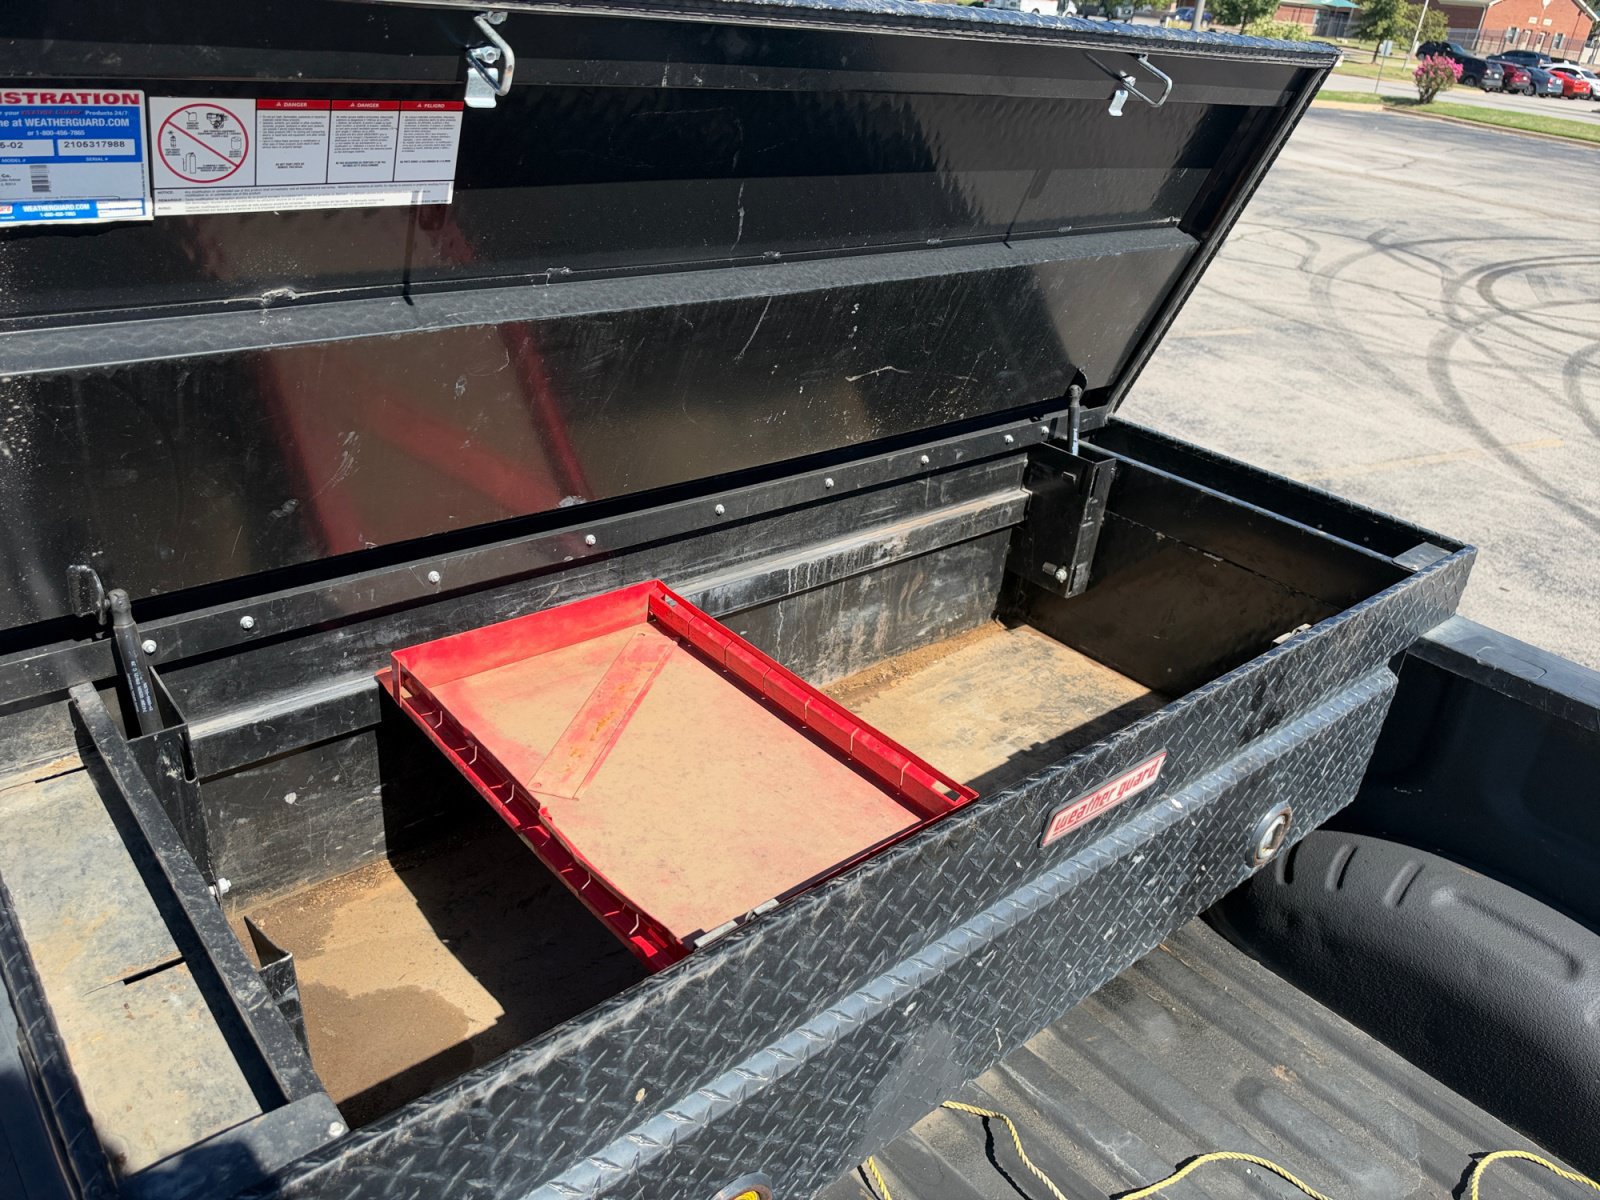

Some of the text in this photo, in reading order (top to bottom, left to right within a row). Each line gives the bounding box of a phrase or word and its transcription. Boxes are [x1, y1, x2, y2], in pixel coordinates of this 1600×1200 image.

[0, 92, 140, 105] STRATION
[12, 118, 23, 127] at
[24, 117, 130, 127] WEATHERGUARD.COM
[1054, 760, 1160, 832] weather guard
